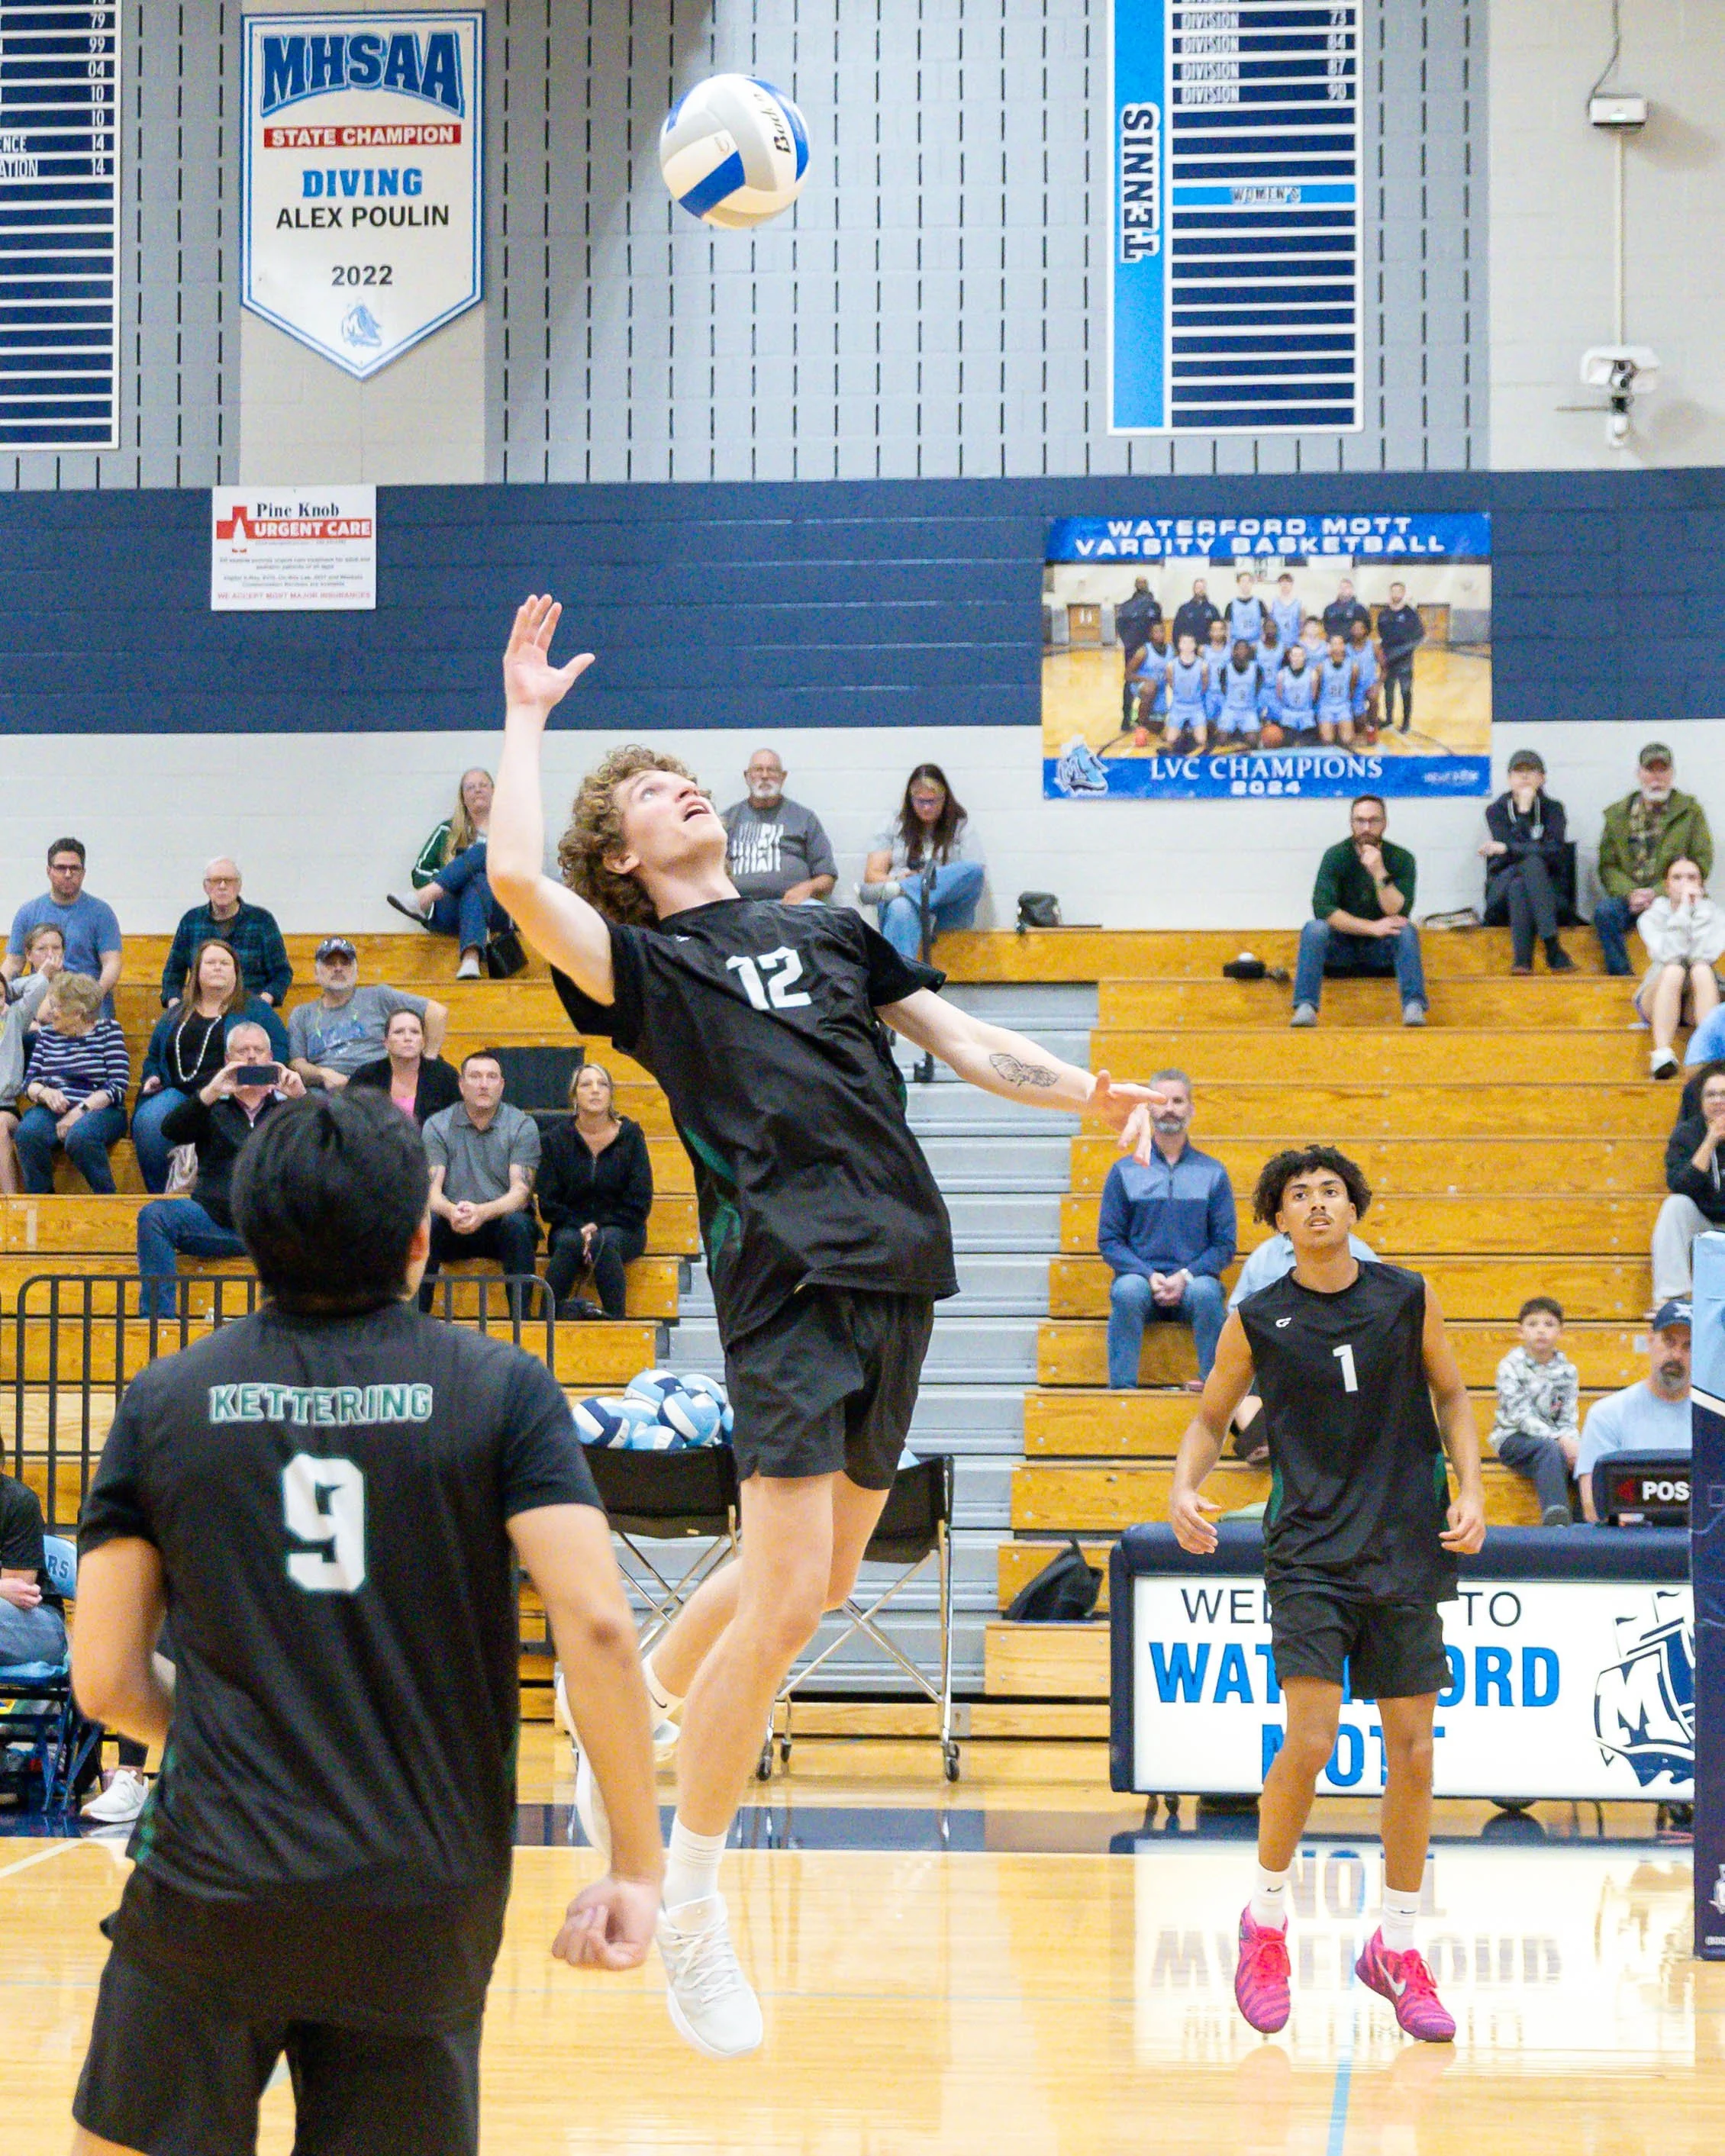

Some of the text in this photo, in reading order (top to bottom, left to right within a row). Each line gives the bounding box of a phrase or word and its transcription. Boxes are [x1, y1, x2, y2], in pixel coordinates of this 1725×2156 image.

[90, 12, 105, 28] 79
[1182, 11, 1239, 29] DIVISION
[89, 37, 105, 53] 99
[1182, 35, 1239, 53] DIVISION
[89, 60, 105, 78] 04
[260, 31, 465, 118] MHSAA
[1182, 62, 1239, 80] DIVISION
[91, 85, 105, 102] 10
[1182, 85, 1239, 104] DIVISION
[92, 109, 105, 127] 10
[92, 134, 105, 152] 14
[272, 126, 453, 146] STATE CHAMPION
[92, 157, 105, 176] 14
[302, 168, 422, 198] DIVING
[1122, 106, 1157, 260] TENNIS
[1232, 186, 1301, 204] WOMEN'S
[276, 205, 449, 229] ALEX POULIN
[331, 264, 393, 286] 2022
[256, 502, 340, 517] Pine Knob
[254, 520, 370, 537] URGENT CARE
[1107, 517, 1411, 537] WATERFORD MOTT
[1075, 536, 1445, 556] VARSITY BASKETBALL
[1150, 756, 1383, 780] LVC CHAMPIONS
[1231, 782, 1301, 795] 2024
[725, 946, 812, 1010] 12
[1333, 1344, 1358, 1392] 1
[208, 1383, 433, 1426] KETTERING
[1643, 1481, 1691, 1501] POS
[282, 1452, 366, 1594] 9
[1459, 1591, 1521, 1627] TO
